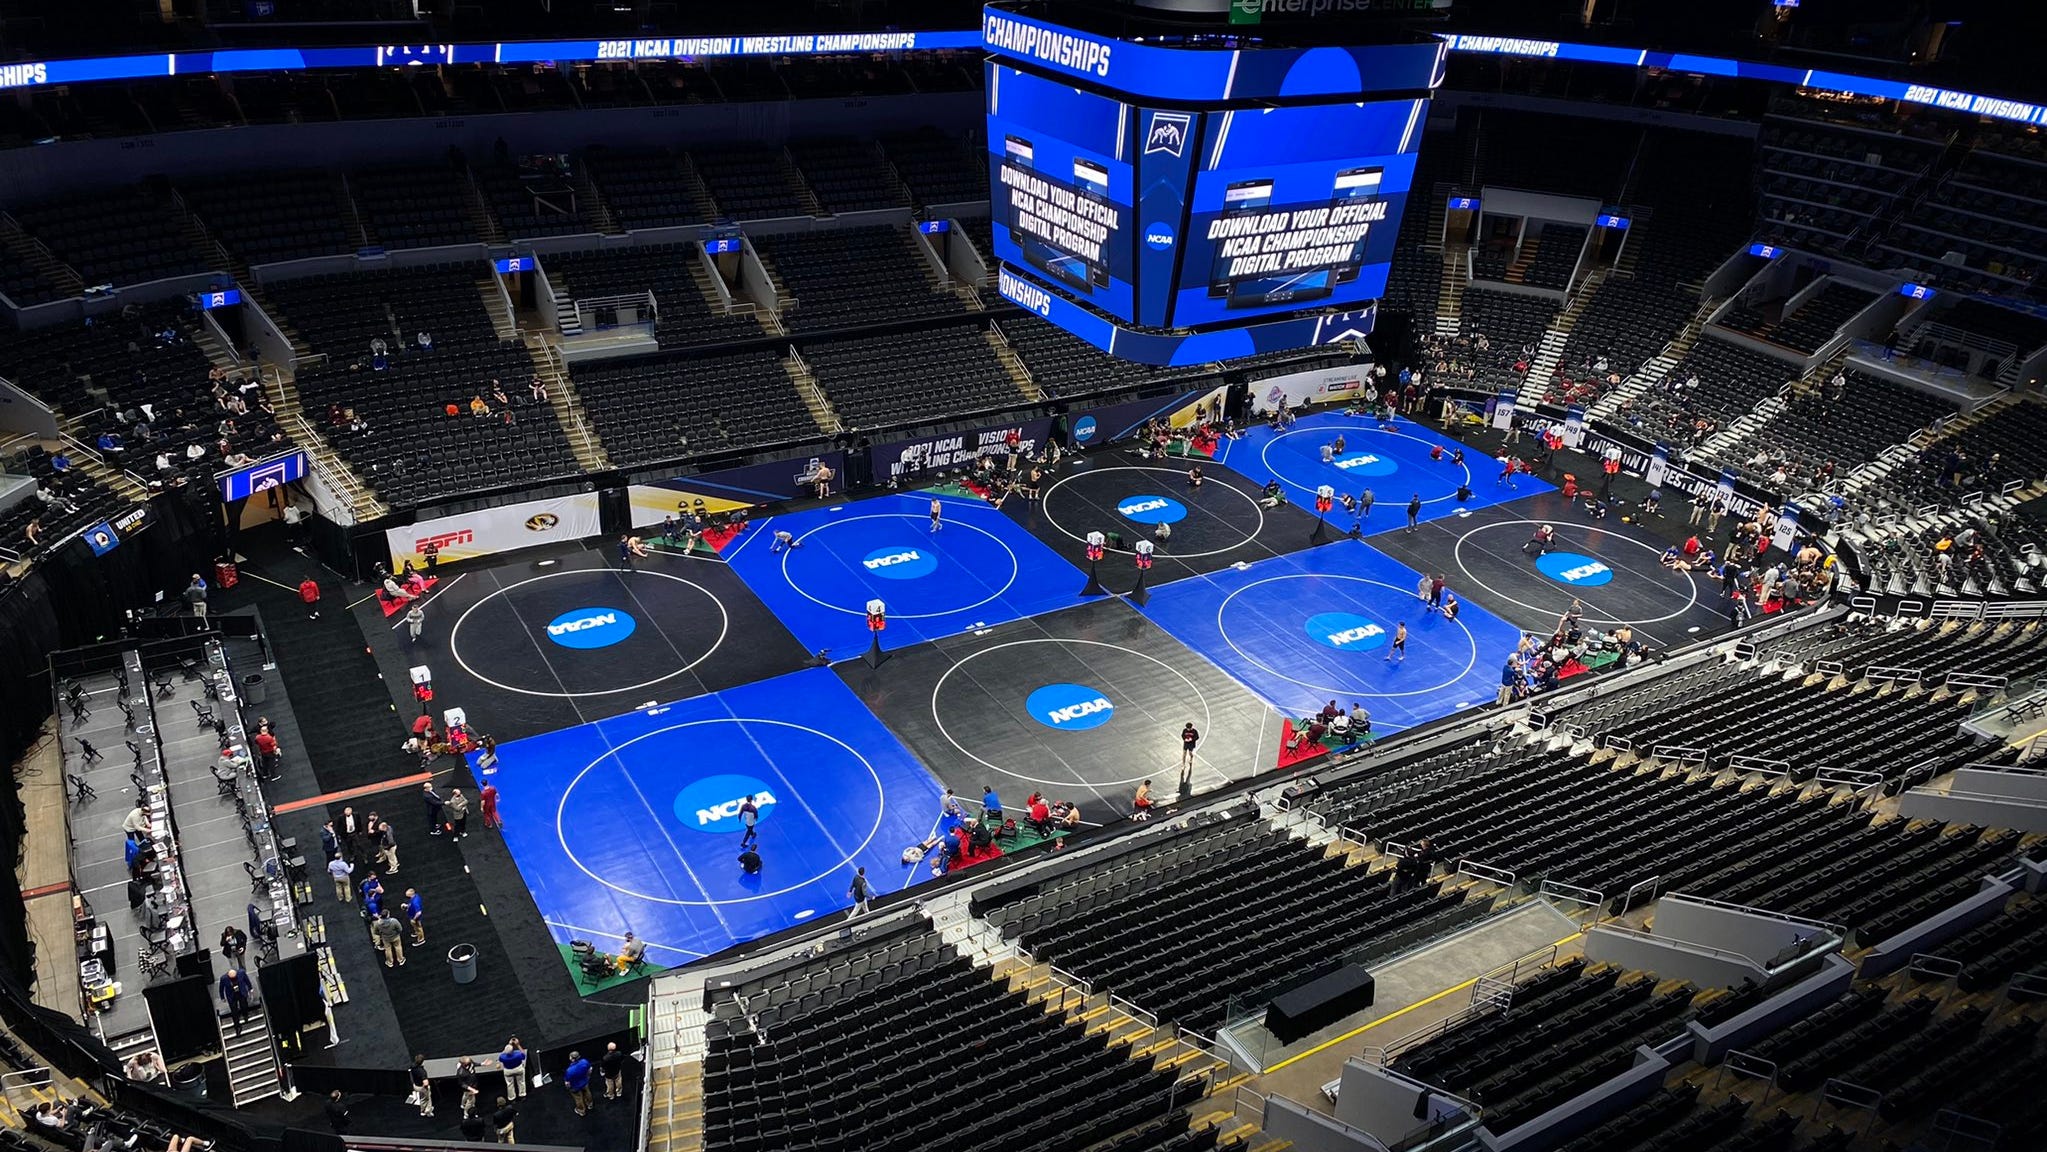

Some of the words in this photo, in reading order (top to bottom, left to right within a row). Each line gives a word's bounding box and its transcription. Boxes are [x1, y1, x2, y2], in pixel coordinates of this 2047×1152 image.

[597, 41, 632, 59] 2021
[634, 39, 671, 58] NCAA
[673, 37, 732, 56] DIVISION
[734, 37, 740, 54] I
[743, 35, 814, 54] WRESTLING
[815, 32, 916, 52] CHAMPIONSHIPS
[986, 15, 1111, 77] CHAMPIONSHIPS
[1458, 36, 1560, 58] CHAMPIONSHIPS
[0, 63, 47, 87] HIPS
[1904, 85, 1937, 105] 2021
[1936, 89, 1970, 111] NCAA
[1971, 96, 2032, 121] DIVISION
[1001, 164, 1049, 200] DOWNLOAD
[1050, 184, 1076, 212] YOUR
[1077, 196, 1119, 230] OFFICIAL
[1011, 188, 1035, 214] NCAA
[1036, 198, 1108, 244] CHAMPIONSHIP
[1207, 211, 1290, 239] DOWNLOAD
[1292, 207, 1328, 231] YOUR
[1329, 202, 1388, 226] OFFICIAL
[1019, 211, 1052, 241] DIGITAL
[1053, 225, 1100, 262] PROGRAM
[1147, 234, 1173, 245] NCAA
[1221, 238, 1263, 258] NCAA
[1261, 223, 1369, 254] CHAMPIONSHIP
[1229, 252, 1281, 277] DIGITAL
[1282, 244, 1355, 270] PROGRAM
[1497, 408, 1510, 417] 157
[1075, 426, 1096, 437] NCAA
[1566, 425, 1578, 435] 149
[934, 436, 963, 454] NCAA
[1333, 455, 1380, 469] NCAA
[1651, 463, 1662, 473] 141
[1661, 466, 1718, 502] RESTLING
[1117, 498, 1169, 515] NCAA
[115, 509, 146, 530] UNITED
[1779, 524, 1793, 536] 125
[415, 529, 473, 554] ESPN
[862, 550, 921, 570] NCAA
[1560, 562, 1610, 581] NCAA
[547, 613, 617, 635] NCAA
[1328, 624, 1386, 646] NCAA
[419, 674, 425, 682] 1
[453, 716, 461, 726] 2
[1048, 698, 1114, 724] NCAA
